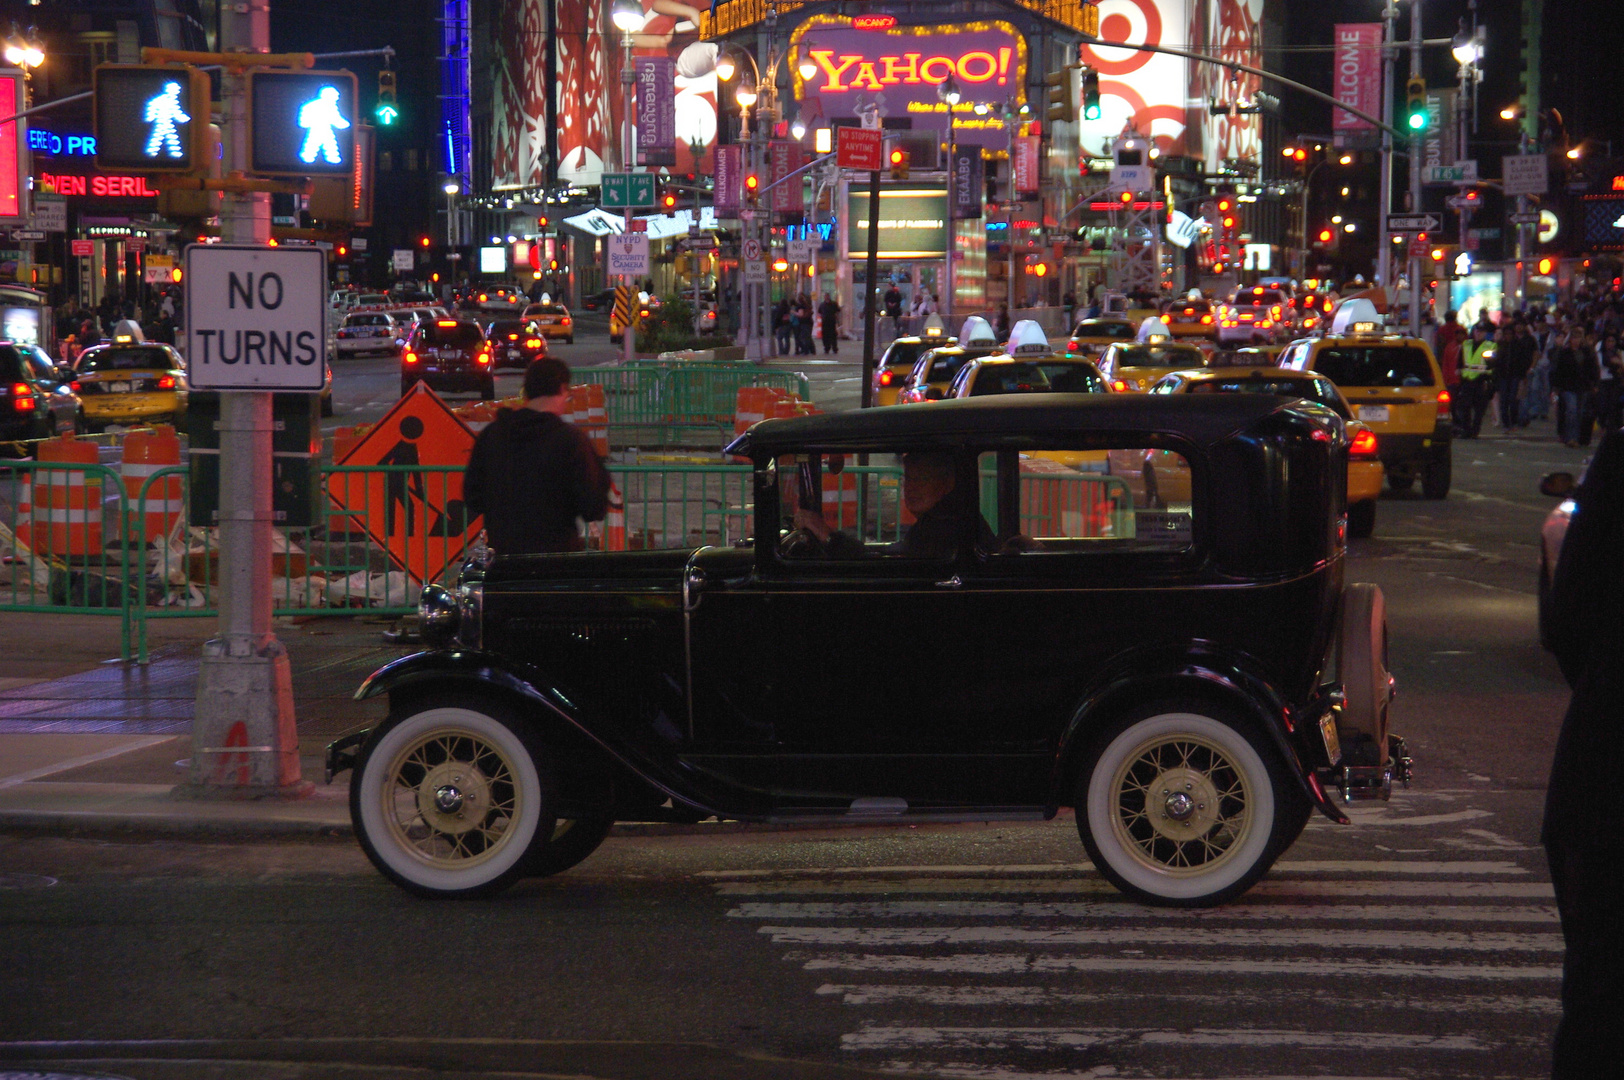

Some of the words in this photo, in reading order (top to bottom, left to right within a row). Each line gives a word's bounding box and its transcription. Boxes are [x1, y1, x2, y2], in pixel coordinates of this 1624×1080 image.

[854, 17, 895, 29] VACANCY
[809, 47, 1012, 93] YAHOO!
[1340, 31, 1360, 124] WELCOME
[1426, 95, 1440, 136] VENIT
[840, 130, 849, 139] NO
[851, 131, 879, 141] STOPPING
[844, 143, 874, 152] ANYTIME
[1426, 138, 1440, 167] BUN
[717, 148, 726, 204] WILLKOMMEN
[776, 145, 789, 209] WELCOME
[90, 227, 131, 235] SEPHORA
[616, 236, 640, 244] NYPD
[612, 253, 646, 261] SECURITY
[228, 271, 284, 310] NO
[196, 329, 317, 366] TURNS
